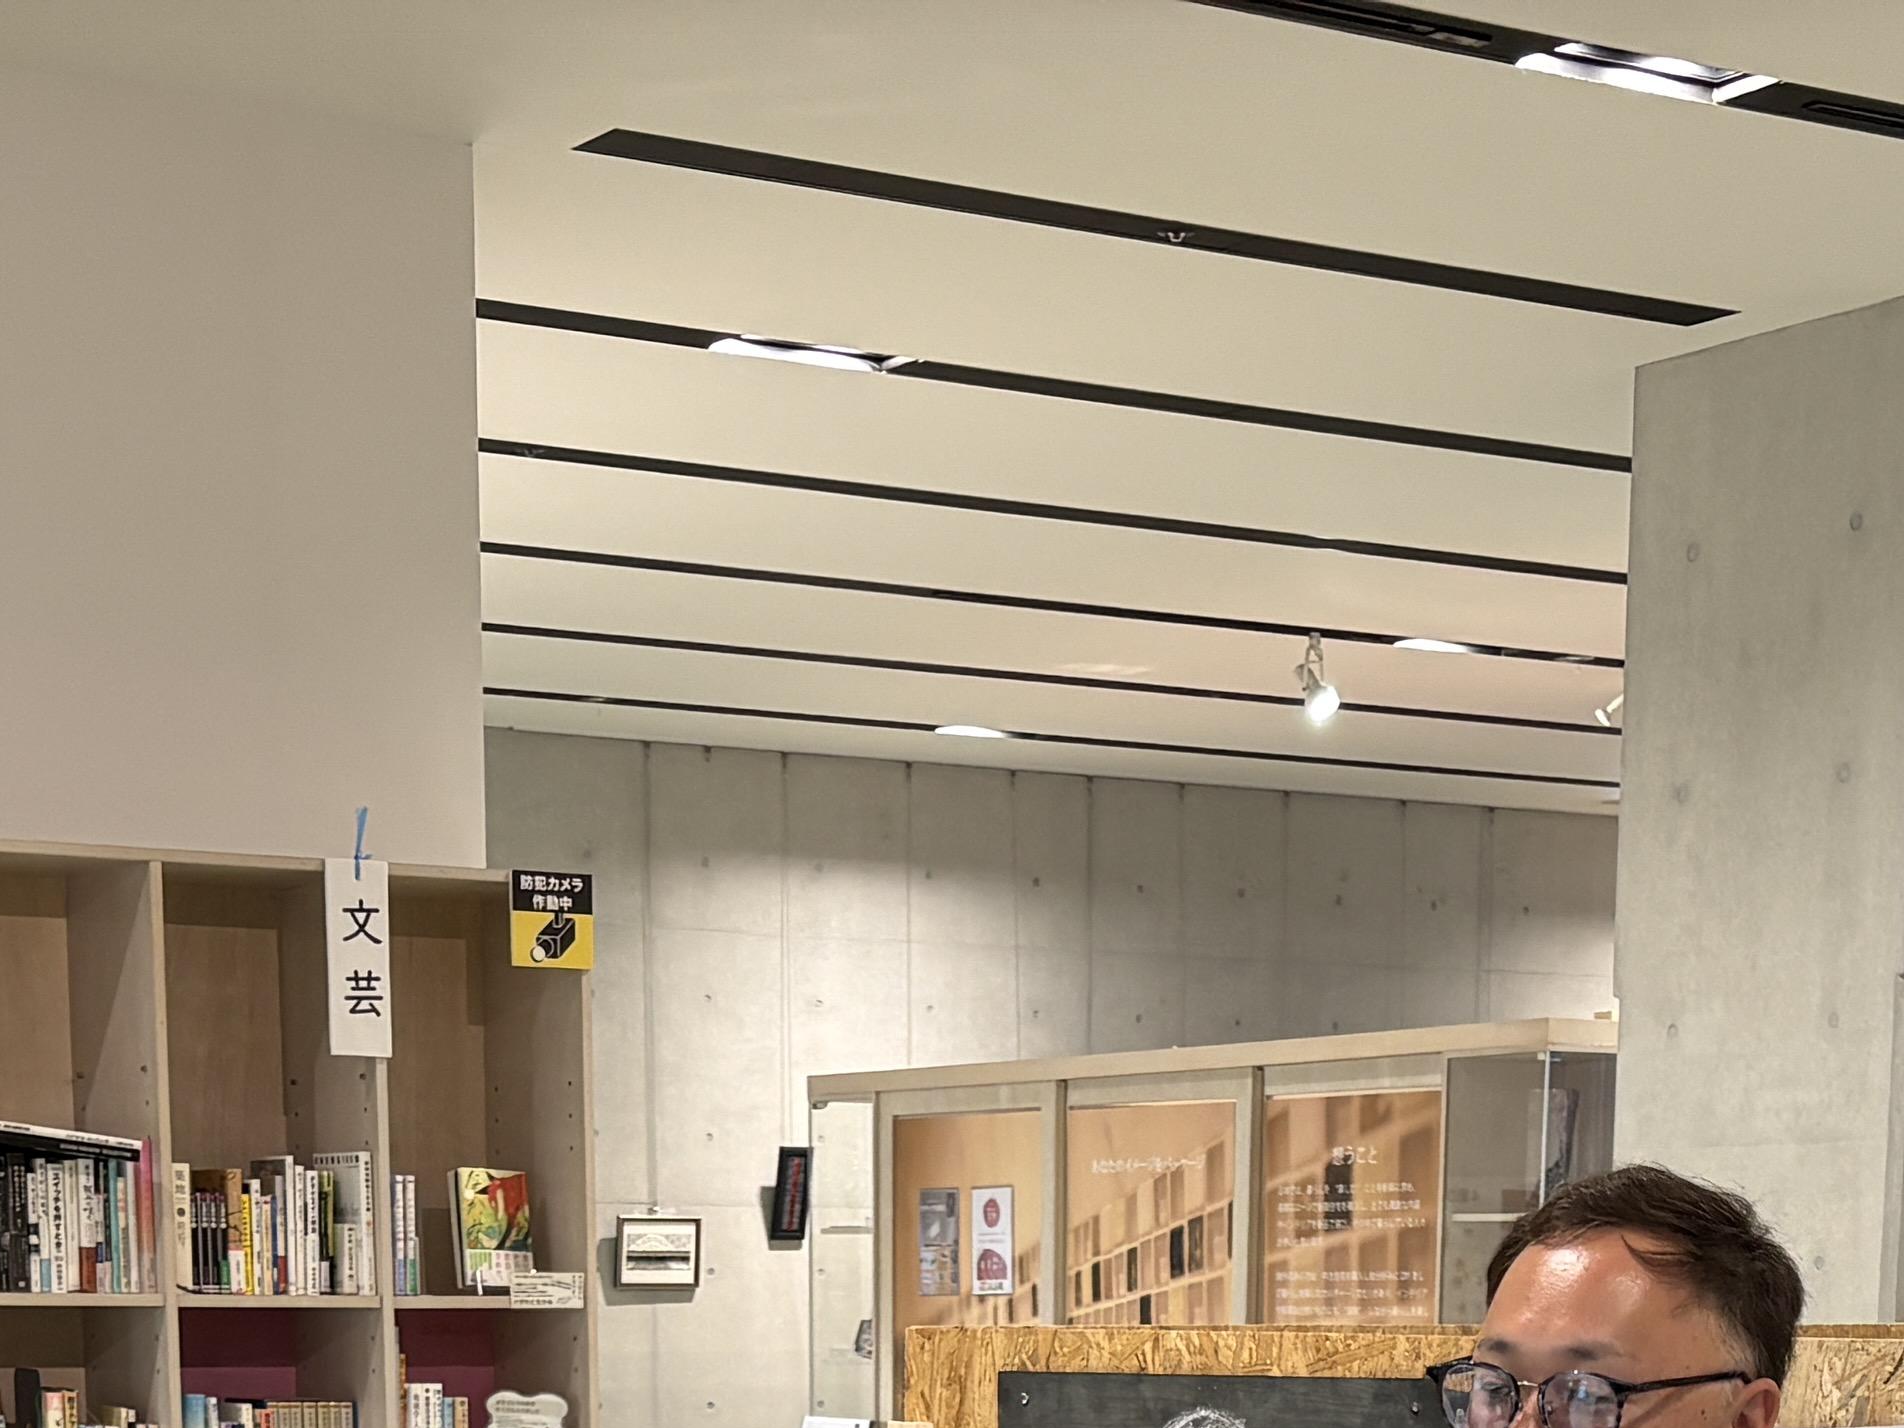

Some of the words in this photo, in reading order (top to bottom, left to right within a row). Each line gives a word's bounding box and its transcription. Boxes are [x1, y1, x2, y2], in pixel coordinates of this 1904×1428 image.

[519, 873, 584, 893] 防犯カメラ
[532, 893, 573, 912] 作動中
[341, 897, 385, 1019] 文芸
